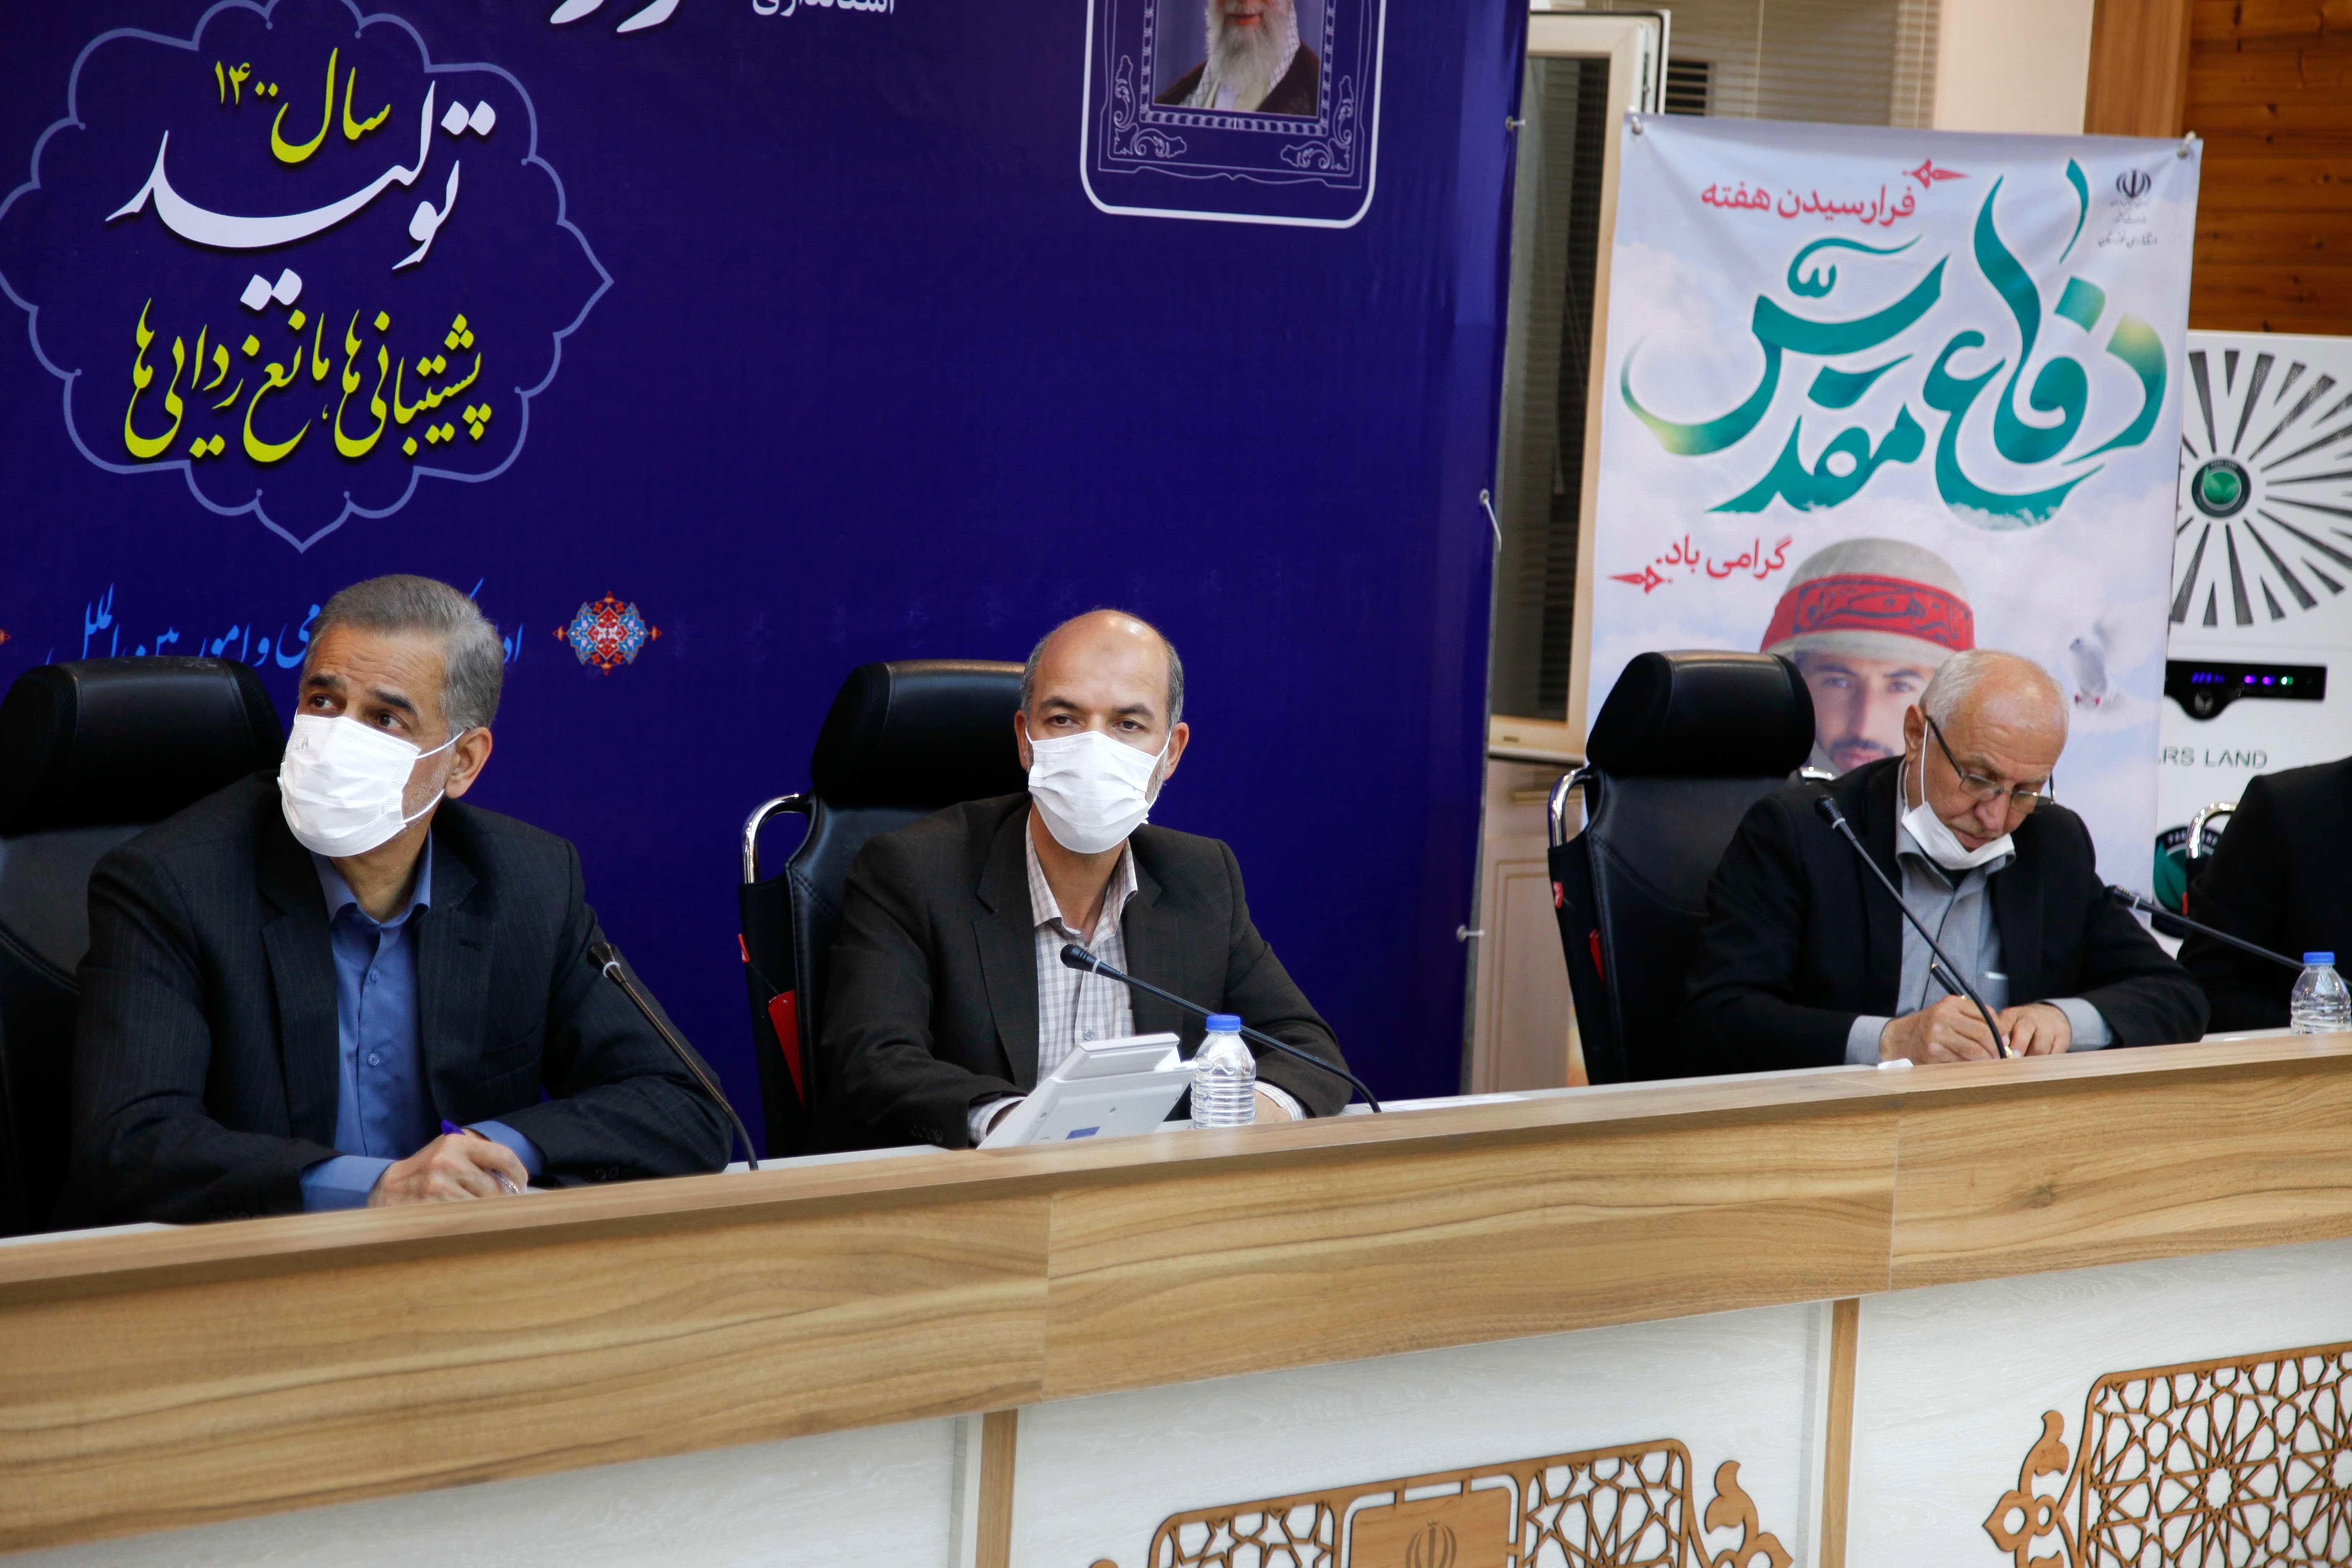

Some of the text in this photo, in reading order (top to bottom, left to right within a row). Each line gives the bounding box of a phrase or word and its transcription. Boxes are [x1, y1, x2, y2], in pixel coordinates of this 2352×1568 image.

[271, 47, 391, 164] سال
[105, 80, 496, 311] تولید
[1702, 182, 1770, 211] هفته
[1706, 535, 1794, 580] گرامی
[2204, 748, 2268, 769] LAND
